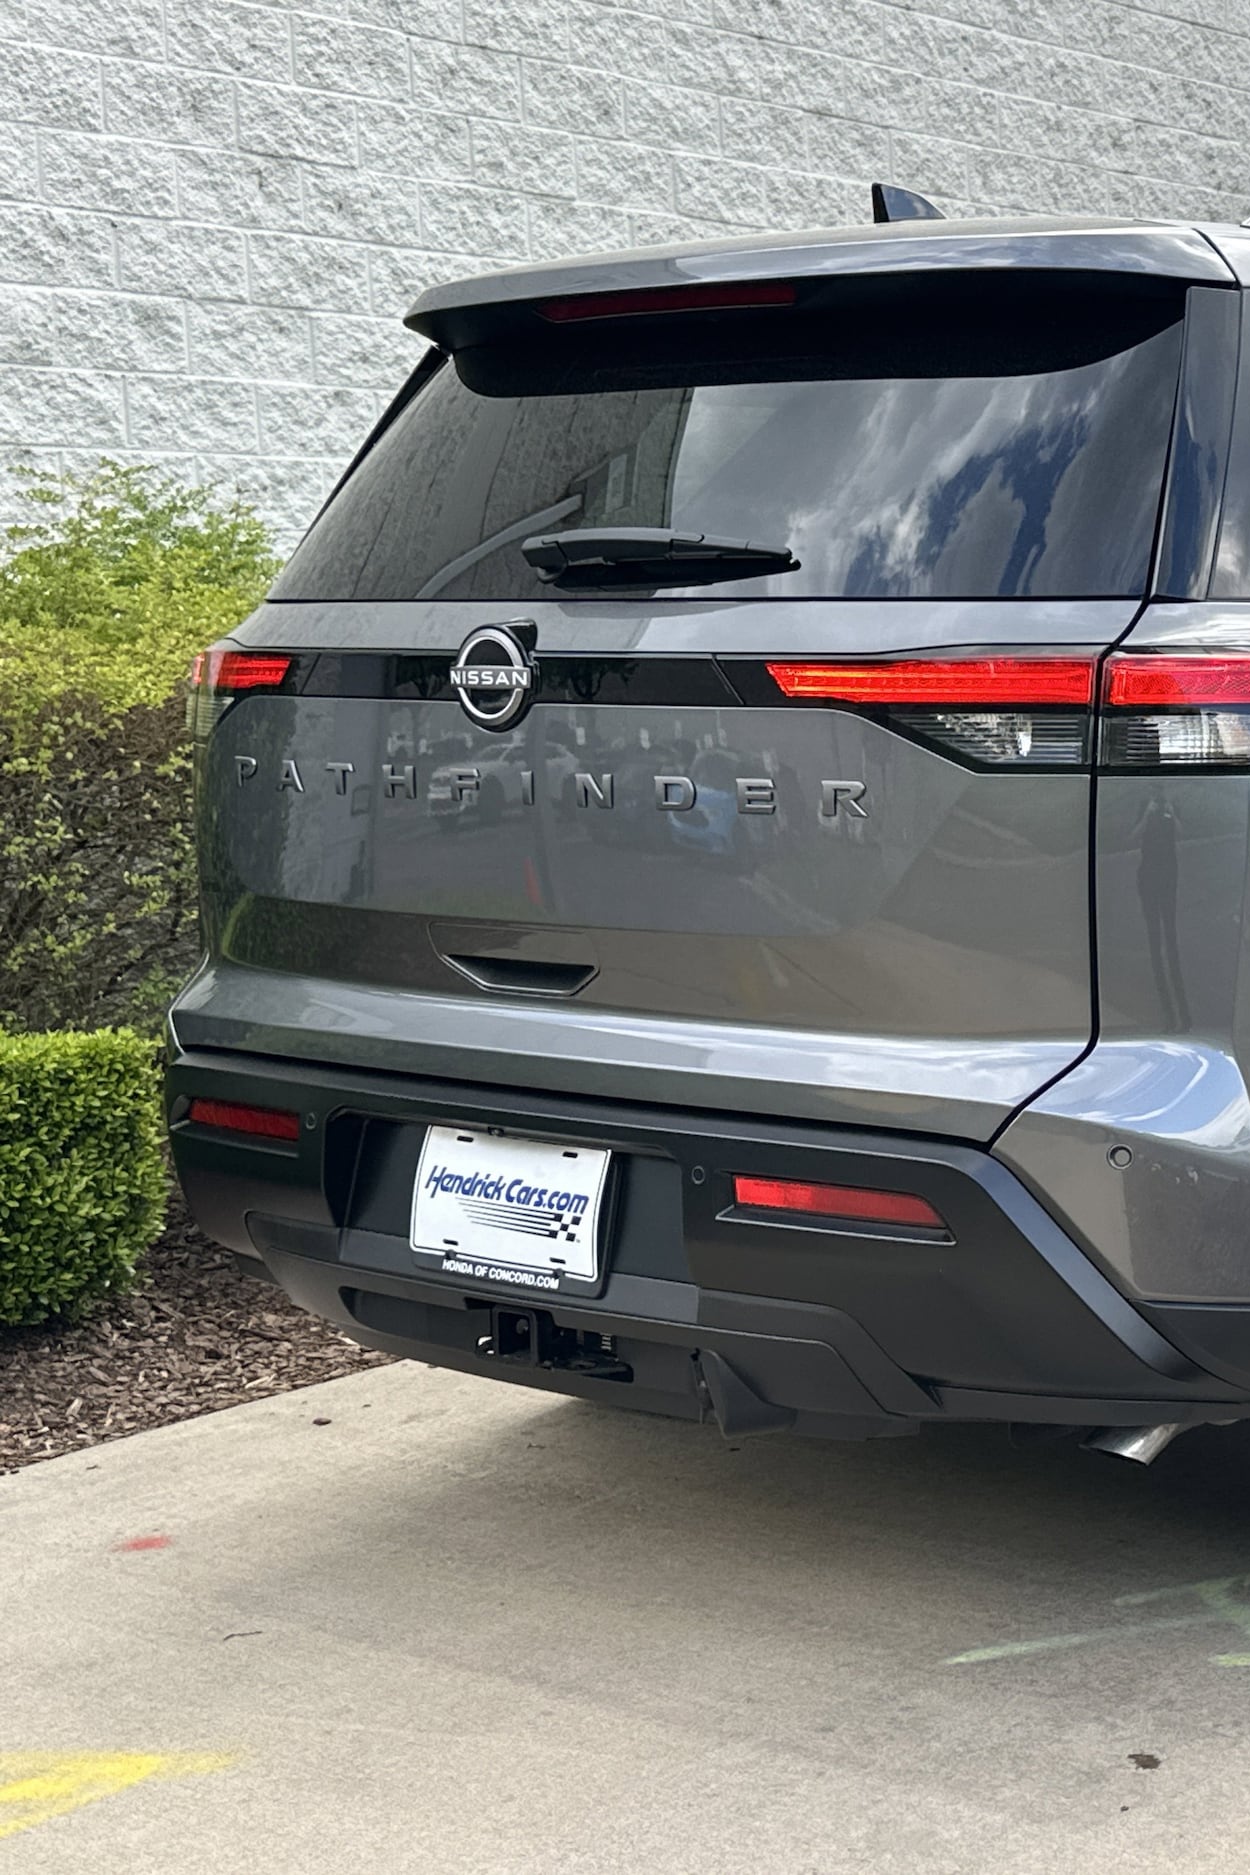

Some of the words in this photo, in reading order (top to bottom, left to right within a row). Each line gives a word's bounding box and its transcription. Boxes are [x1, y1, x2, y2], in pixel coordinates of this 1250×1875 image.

[450, 670, 528, 686] NISSAN
[234, 756, 870, 820] PATHFINDER
[442, 1259, 474, 1275] HONDA
[474, 1266, 488, 1278] OF
[488, 1268, 560, 1290] CONCORD.COM
